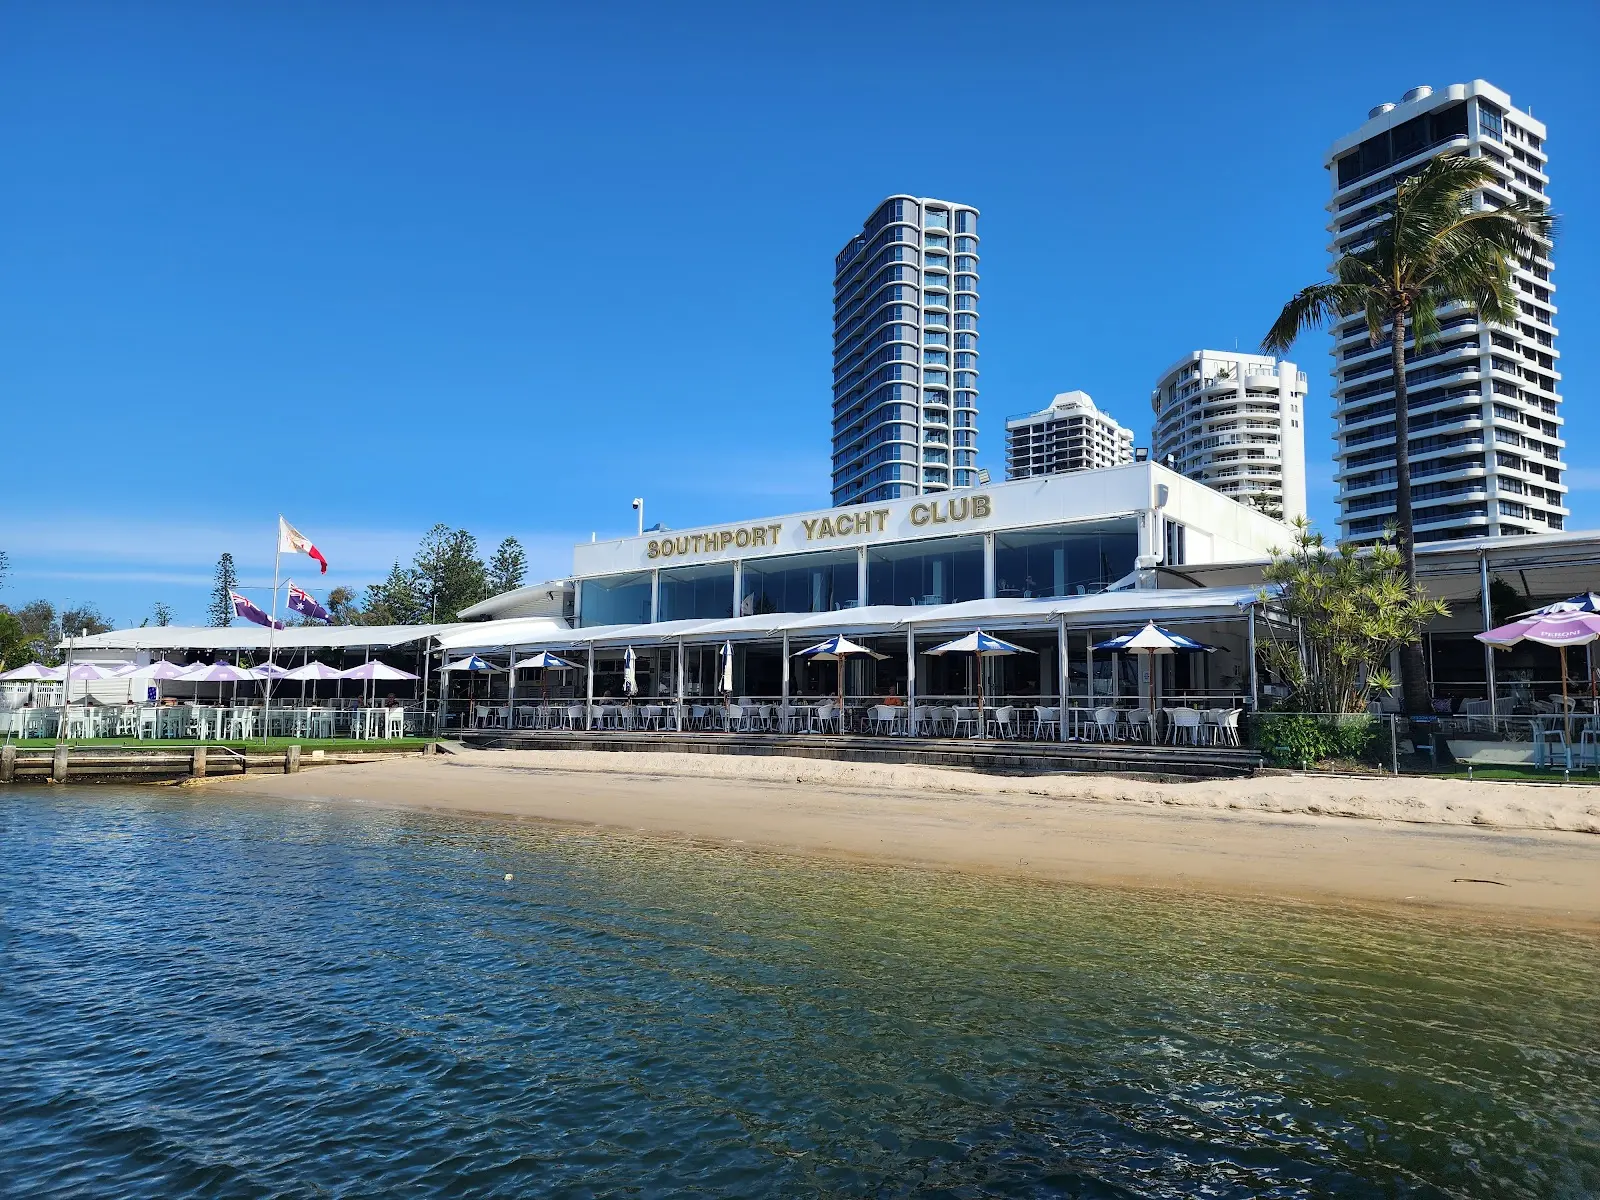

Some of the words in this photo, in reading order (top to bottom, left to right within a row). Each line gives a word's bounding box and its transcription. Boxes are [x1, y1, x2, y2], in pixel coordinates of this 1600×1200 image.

[647, 523, 782, 559] SOUTHPORT
[802, 508, 890, 541] YACHT
[910, 494, 992, 527] CLUB
